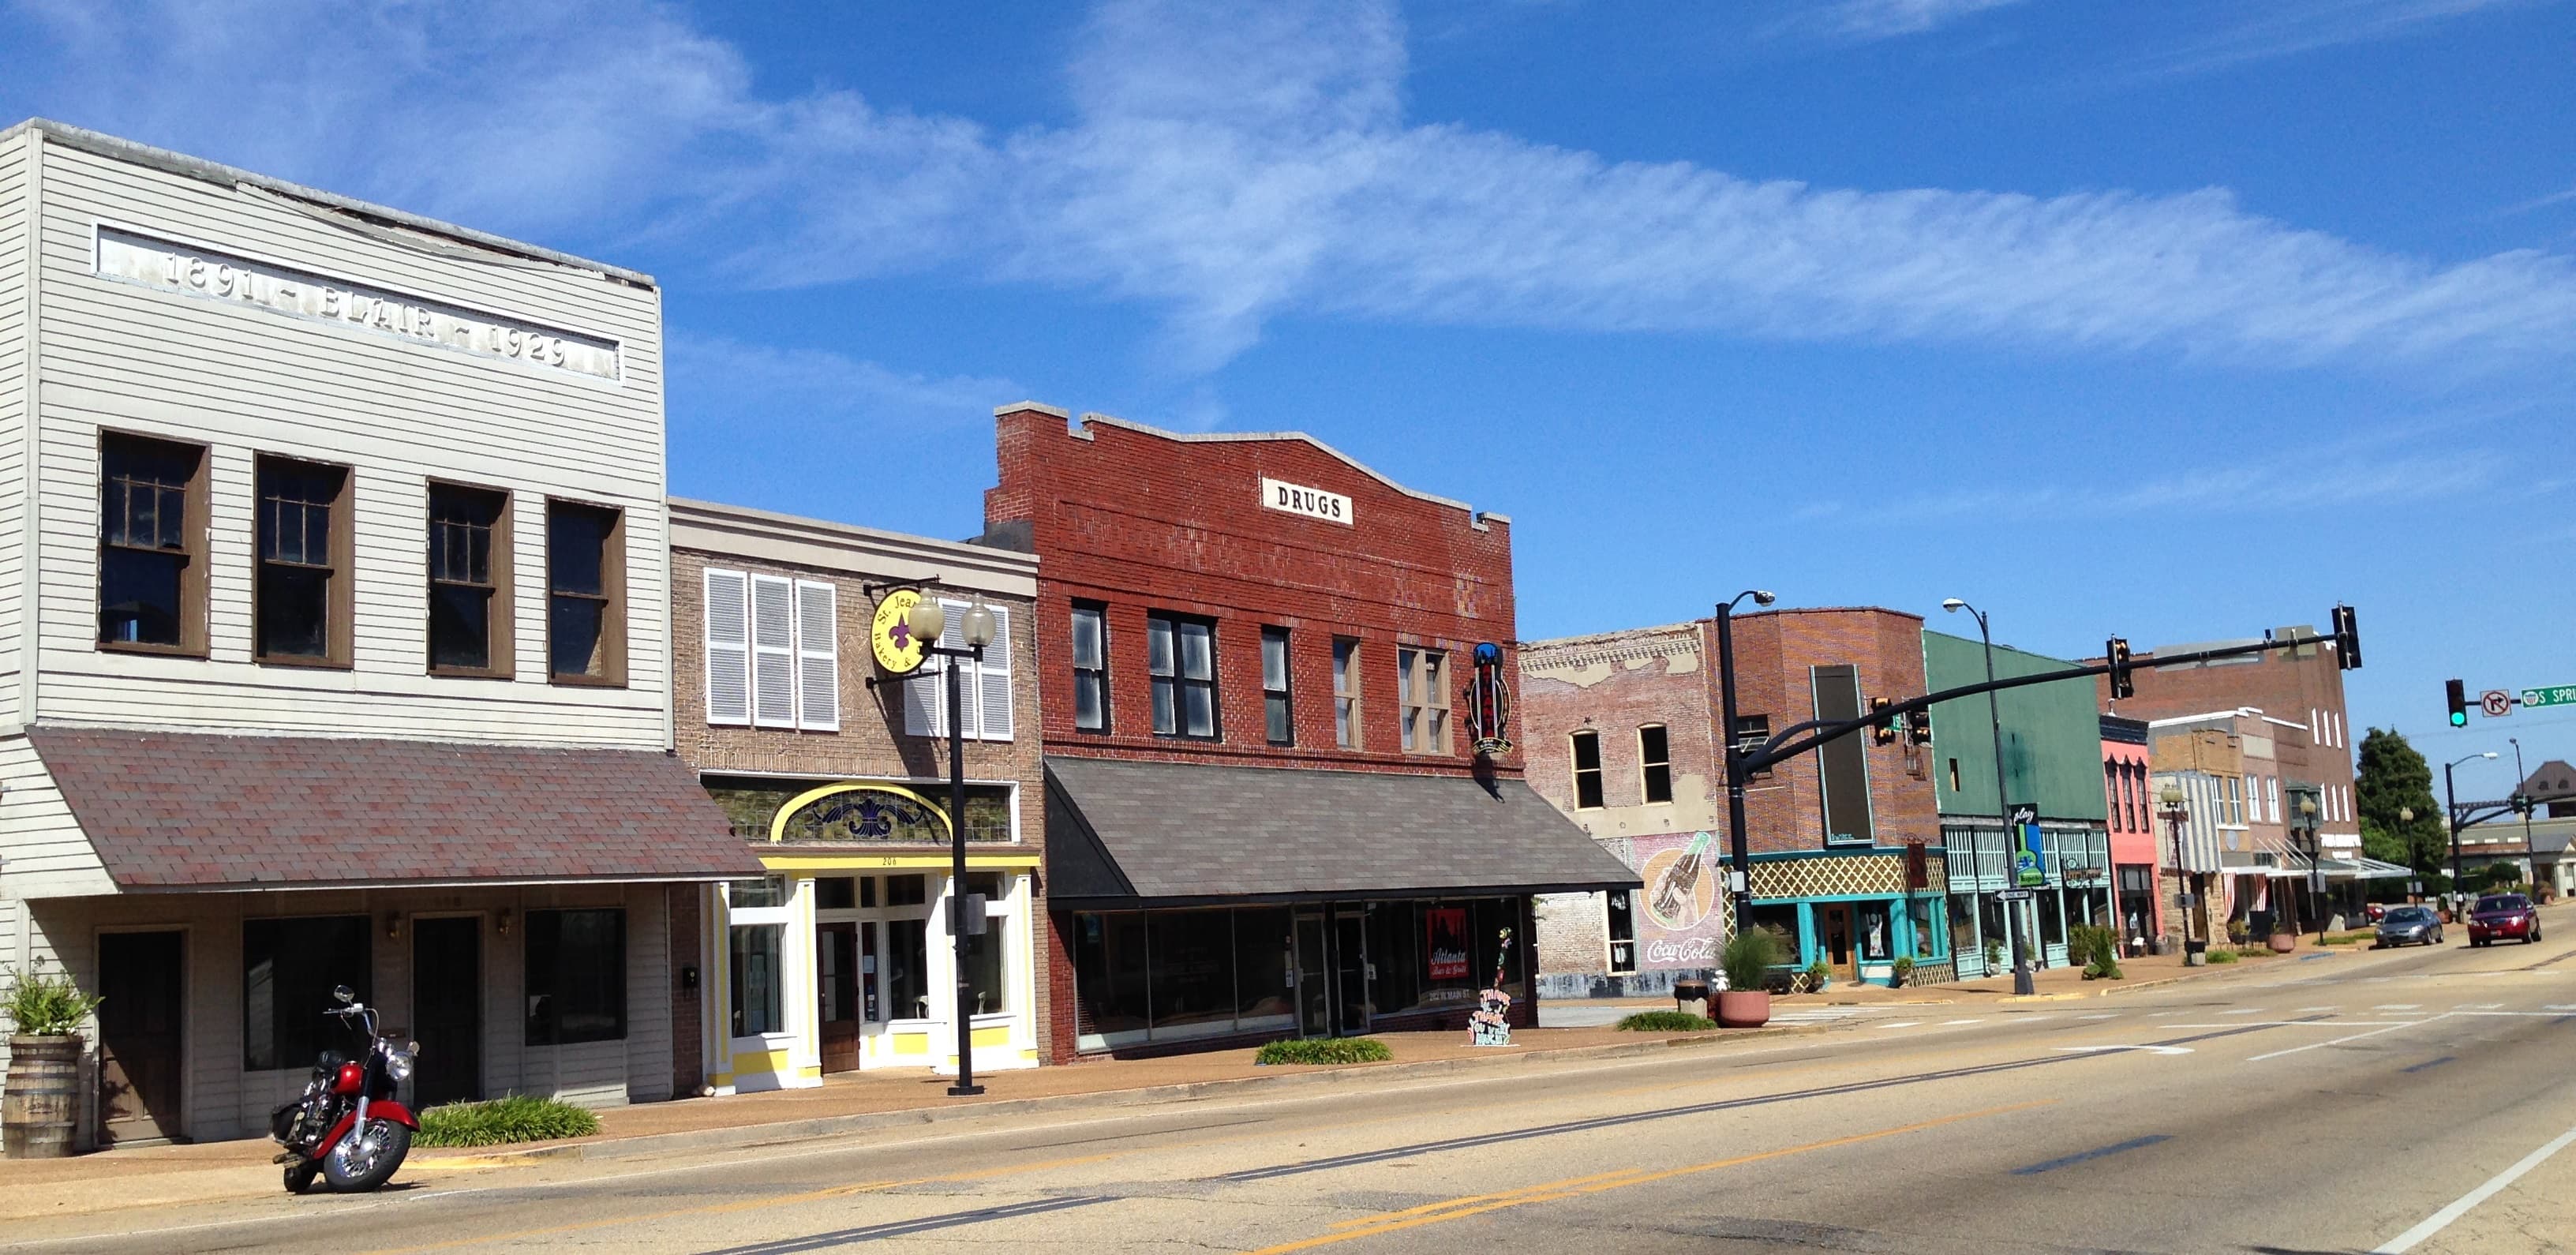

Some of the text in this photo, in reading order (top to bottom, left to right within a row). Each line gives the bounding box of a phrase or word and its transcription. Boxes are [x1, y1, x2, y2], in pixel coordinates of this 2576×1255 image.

[165, 253, 253, 299] 1891
[320, 286, 435, 337] BLAIR
[491, 324, 566, 367] 1929
[1278, 486, 1341, 518] DRUGS
[878, 610, 891, 624] St.
[874, 632, 897, 669] Bakery
[904, 657, 911, 668] &
[2539, 691, 2546, 703] S
[2014, 807, 2035, 826] play
[1431, 947, 1466, 965] Atlanta
